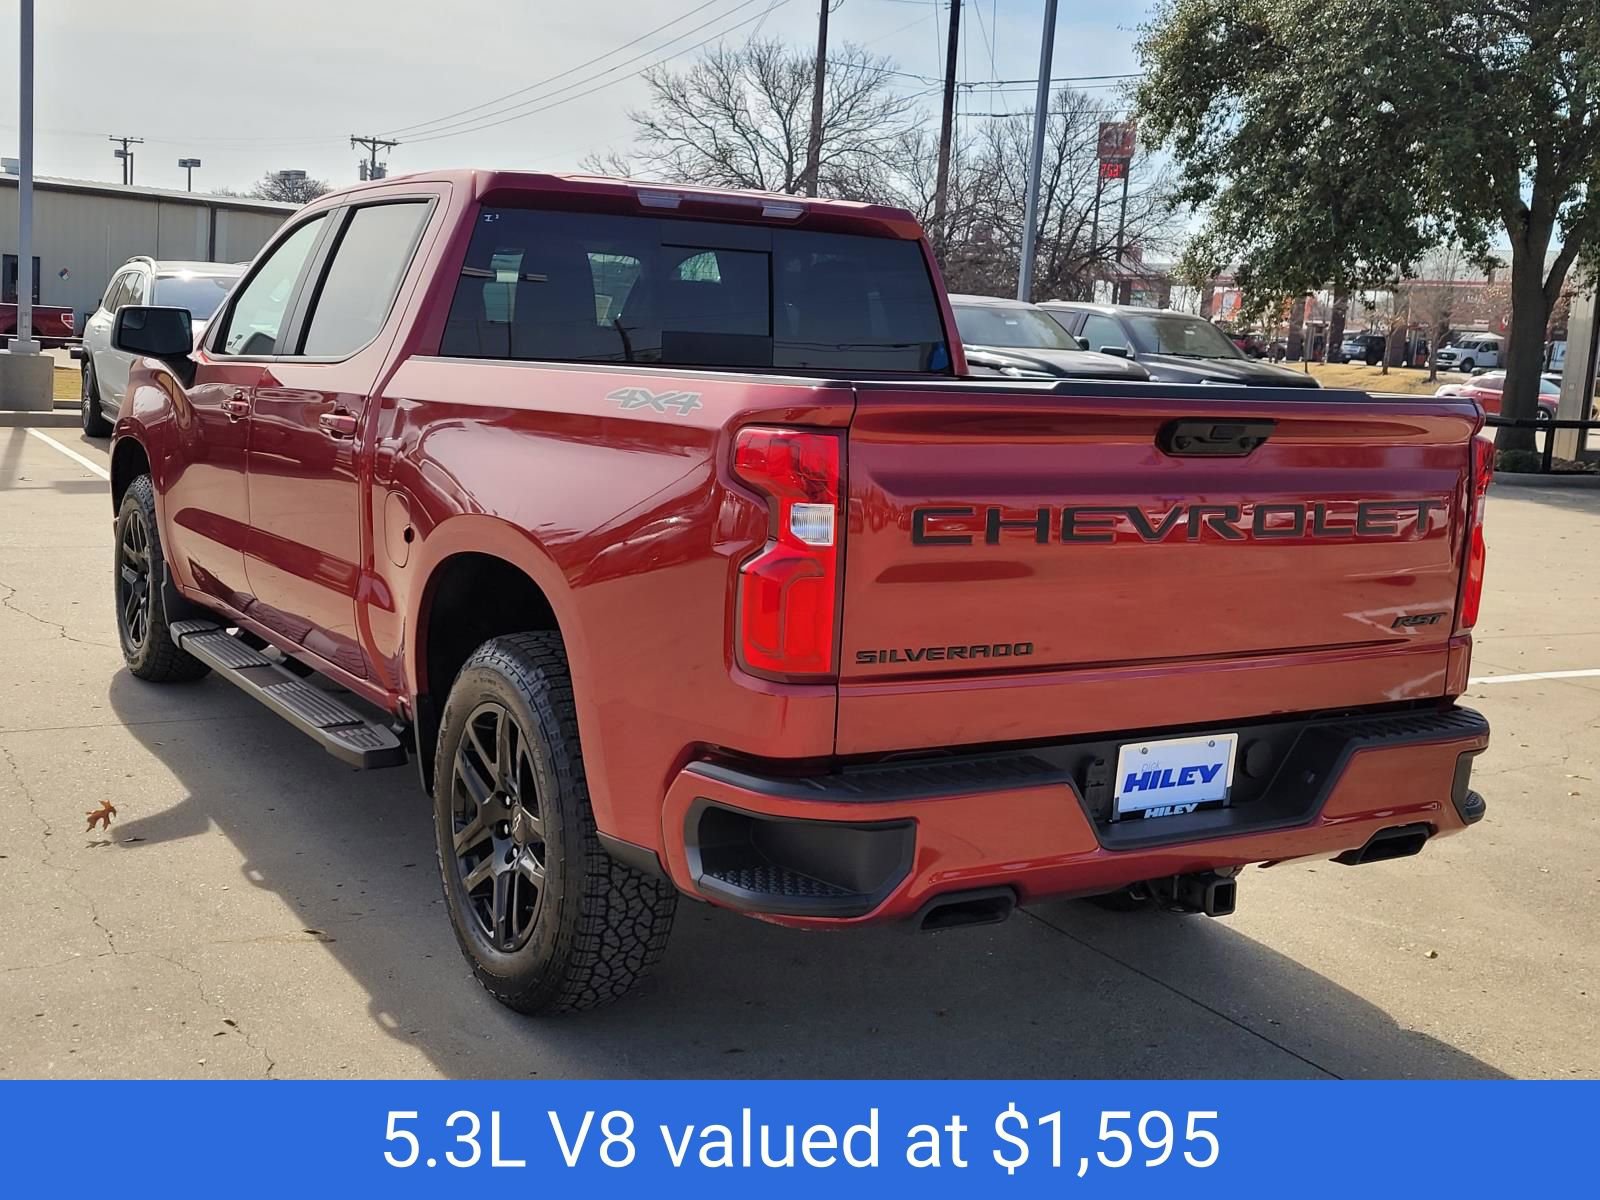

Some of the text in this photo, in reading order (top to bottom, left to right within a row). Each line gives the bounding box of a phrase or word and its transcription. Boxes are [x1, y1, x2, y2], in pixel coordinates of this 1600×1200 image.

[911, 499, 1447, 547] CHEVROLET
[1391, 612, 1447, 628] RST
[856, 642, 1034, 664] SILVERADO
[1123, 763, 1223, 793] HILEY
[1143, 802, 1198, 819] HILEY
